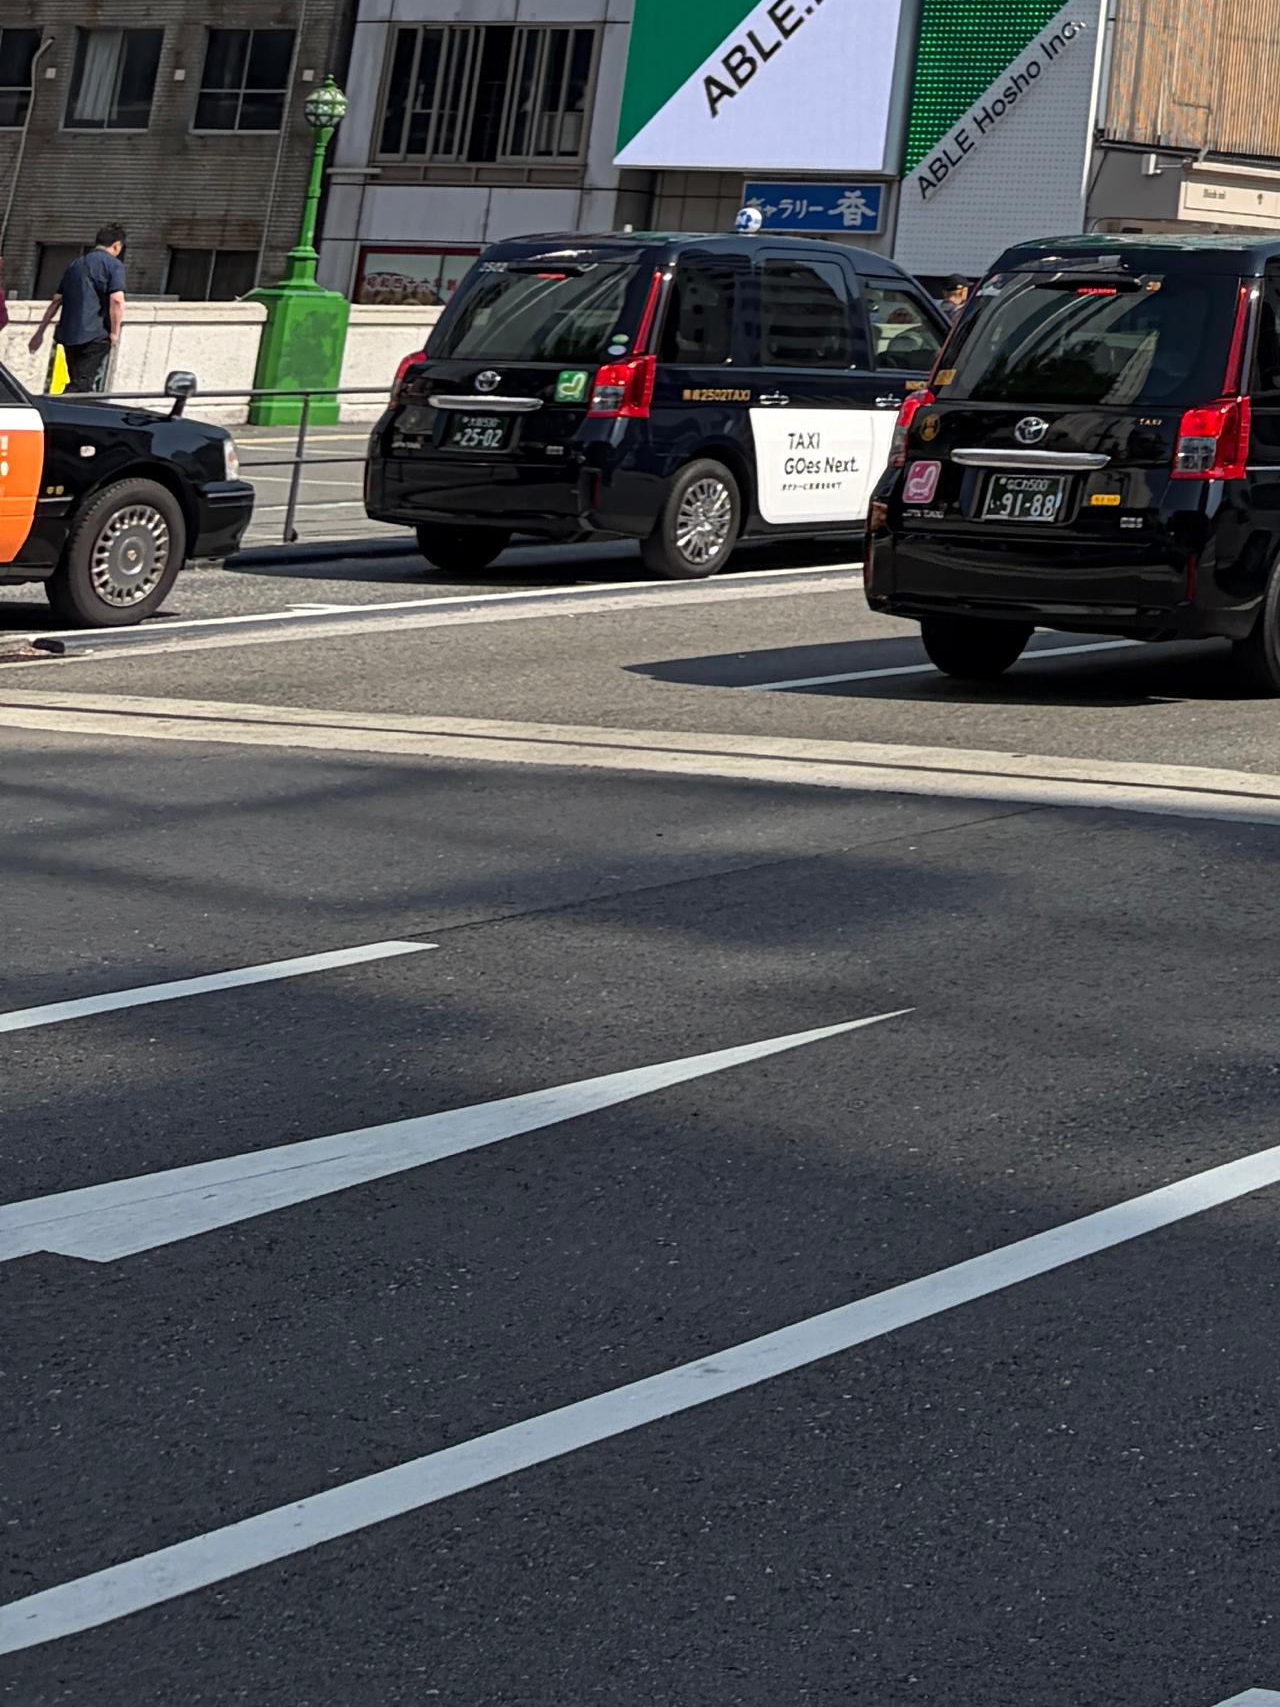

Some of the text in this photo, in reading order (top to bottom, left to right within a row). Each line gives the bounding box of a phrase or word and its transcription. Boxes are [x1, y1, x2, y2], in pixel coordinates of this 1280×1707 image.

[916, 21, 1087, 200] ABLE Hosho Inc.
[827, 189, 877, 227] 香
[459, 428, 503, 449] 25-02
[788, 432, 820, 450] TAXI
[784, 458, 820, 476] GOes
[1000, 491, 1055, 517] 91-88
